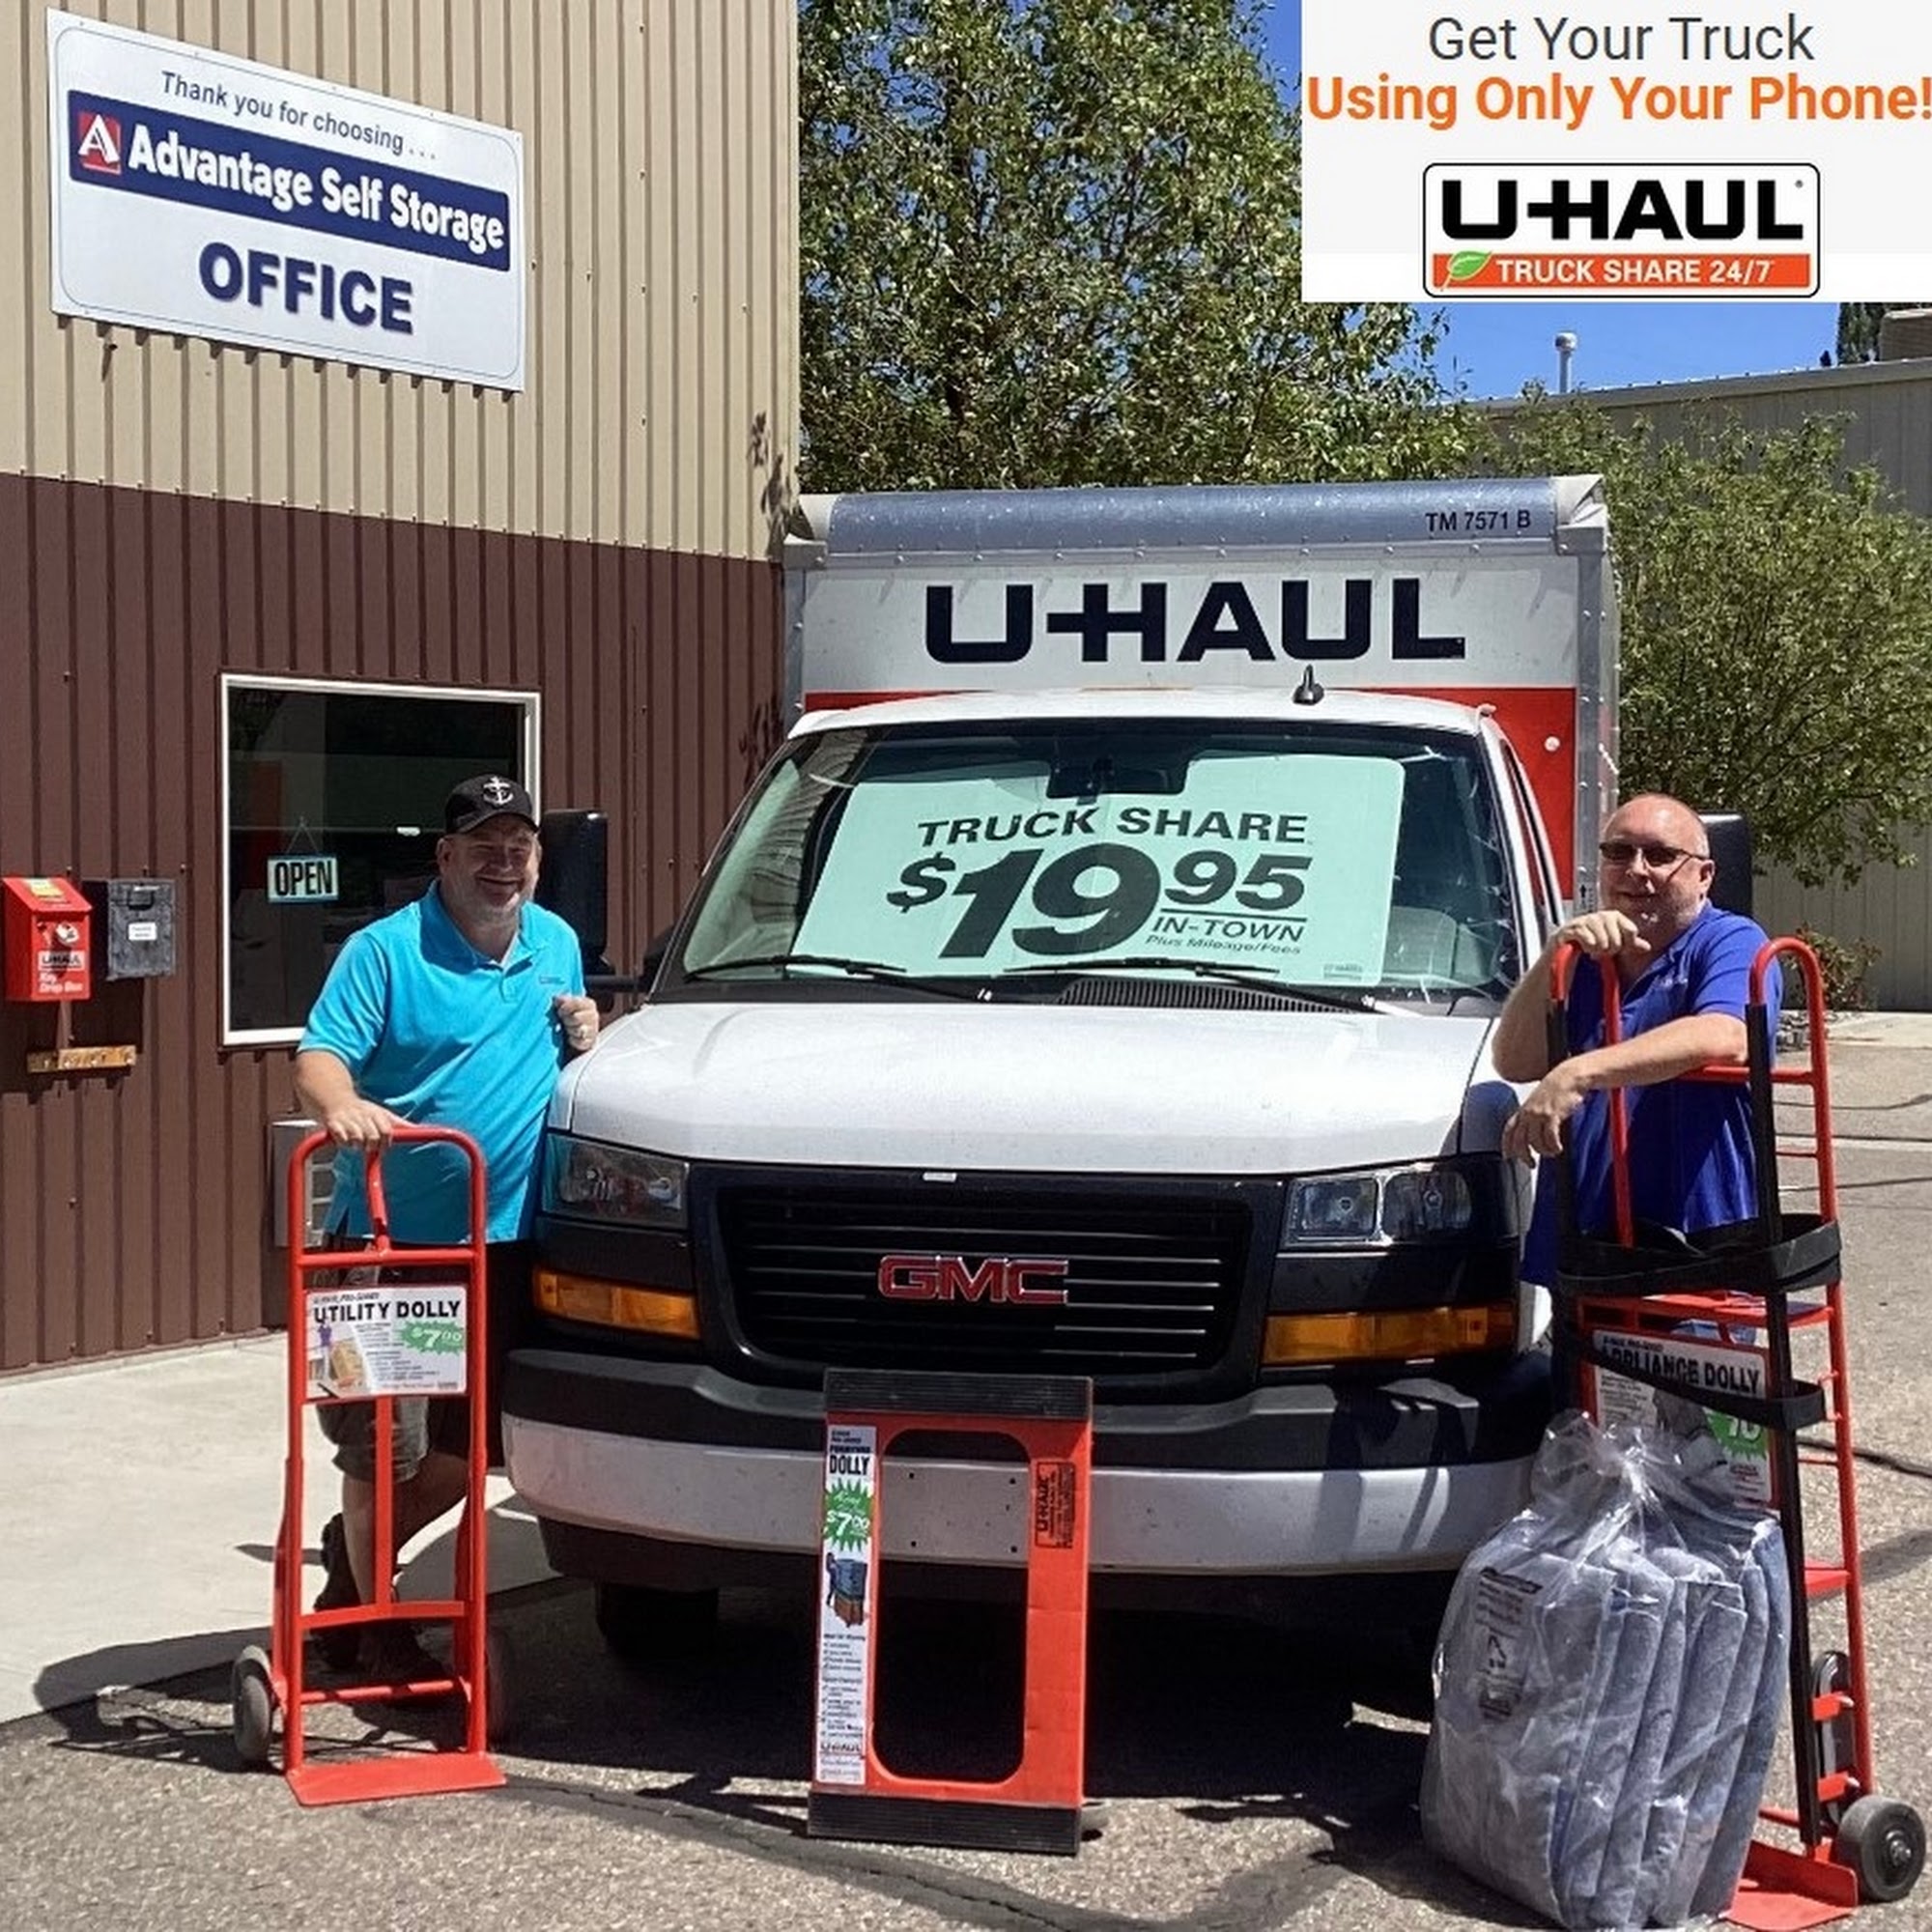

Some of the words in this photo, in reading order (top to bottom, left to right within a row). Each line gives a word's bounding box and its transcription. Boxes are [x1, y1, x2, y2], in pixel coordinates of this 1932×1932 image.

[161, 71, 228, 107] Thank
[234, 93, 273, 117] you
[279, 100, 308, 127] for
[313, 112, 404, 156] choosing
[128, 123, 314, 212] Advantage
[321, 167, 384, 221] Self
[389, 184, 505, 255] Storage
[199, 242, 414, 335] OFFICE
[1425, 512, 1458, 531] TM
[1464, 511, 1508, 530] 7571
[1517, 509, 1531, 528] B
[926, 579, 1466, 663] U-HAUL
[919, 807, 1099, 847] TRUCK
[1117, 807, 1308, 843] SHARE
[274, 860, 332, 896] OPEN
[1145, 934, 1182, 947] Plus
[1186, 938, 1302, 955] Mileage/Fees
[1155, 917, 1306, 943] IN-TOWN
[878, 1255, 1069, 1304] GMC
[314, 1301, 390, 1323] UTILITY
[396, 1300, 462, 1319] DOLLY
[1704, 1362, 1760, 1394] DOLLY
[829, 1454, 869, 1475] DOLLY
